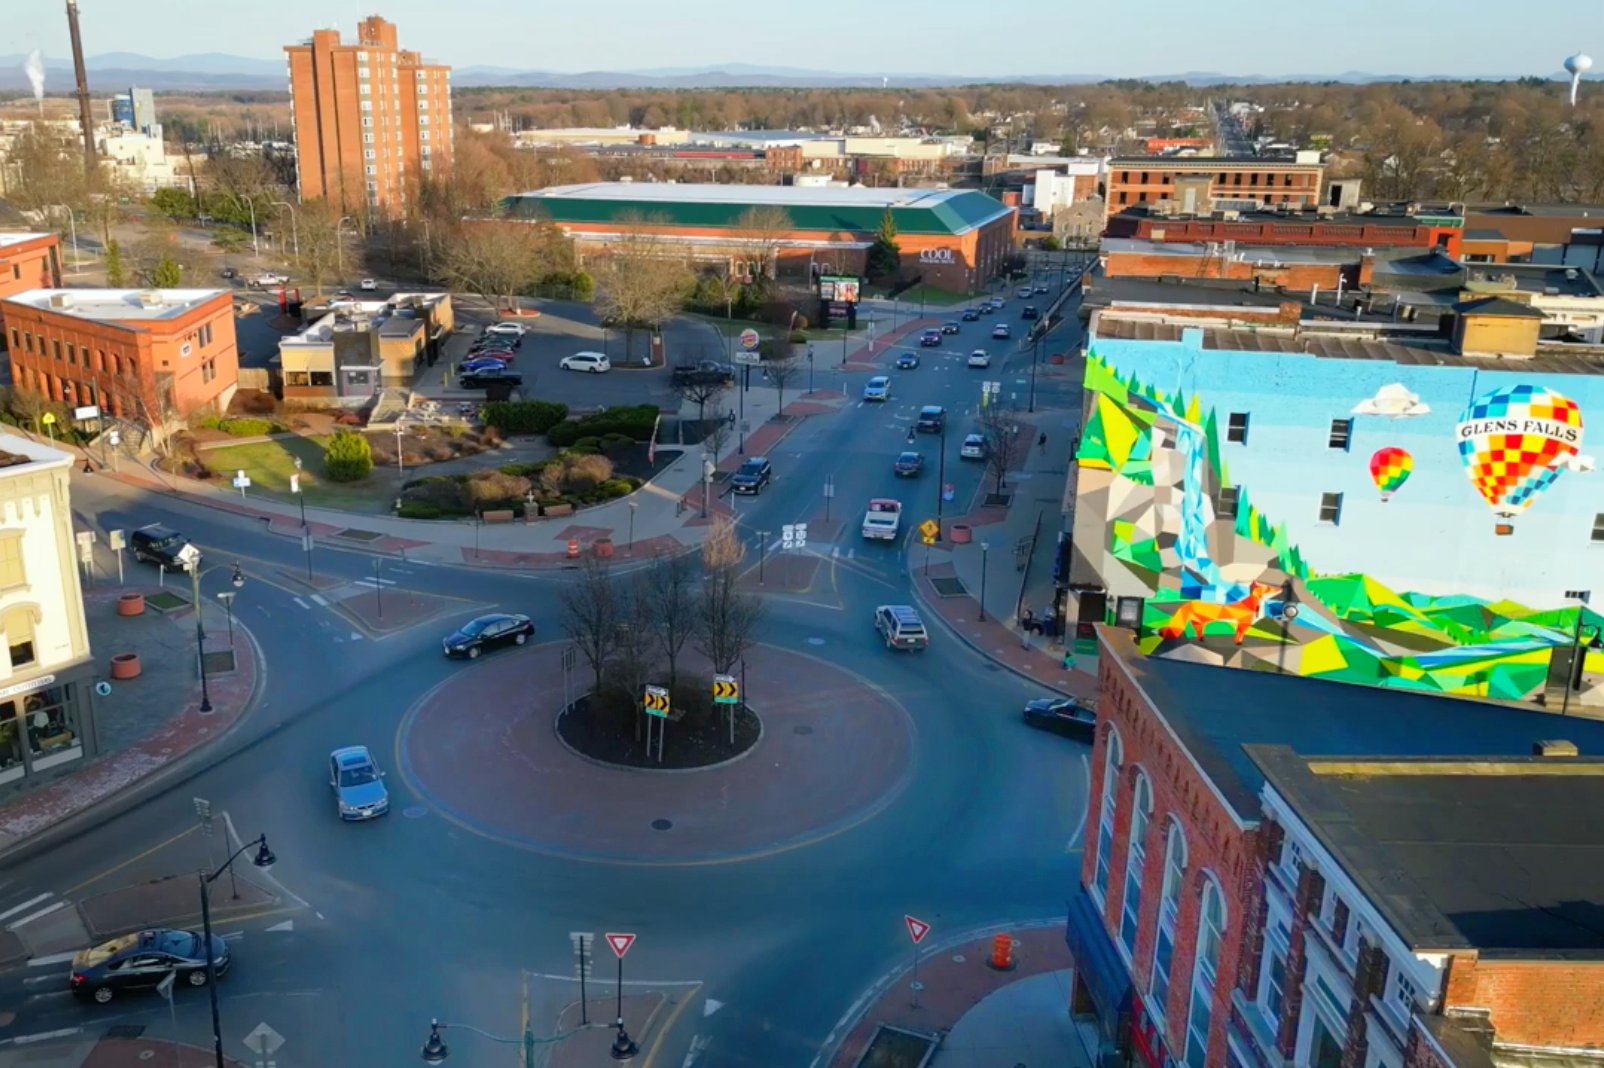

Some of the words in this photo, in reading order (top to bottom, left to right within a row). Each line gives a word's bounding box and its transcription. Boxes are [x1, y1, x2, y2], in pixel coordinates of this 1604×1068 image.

[920, 247, 953, 260] COOL
[1461, 419, 1518, 438] GLENS
[1523, 420, 1578, 442] FALLS
